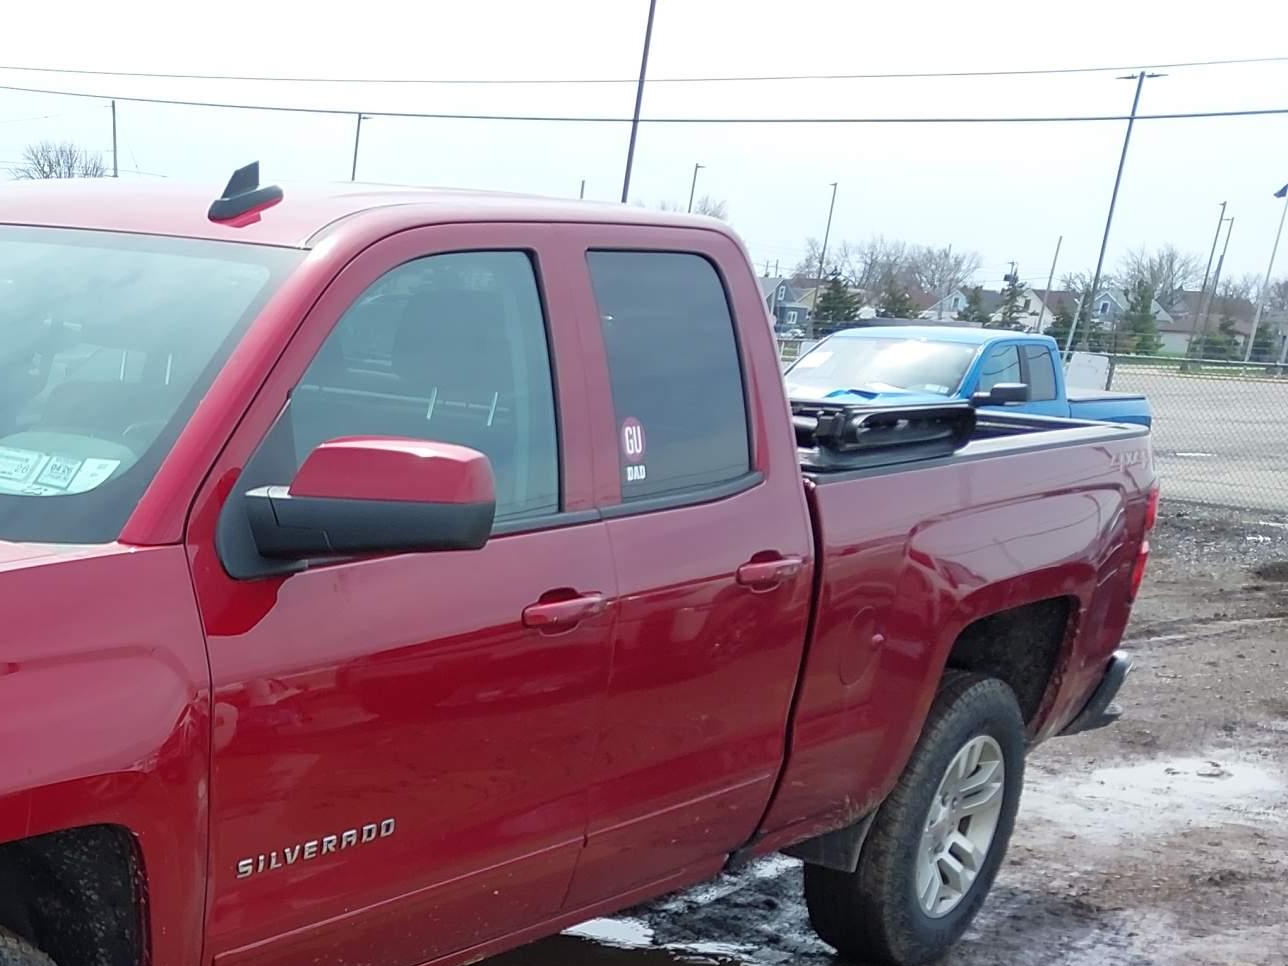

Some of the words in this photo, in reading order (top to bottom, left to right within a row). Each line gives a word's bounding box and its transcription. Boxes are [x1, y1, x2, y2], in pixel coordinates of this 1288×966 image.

[624, 425, 643, 455] GU
[626, 465, 646, 481] DAD
[236, 817, 396, 879] SILVERADO
